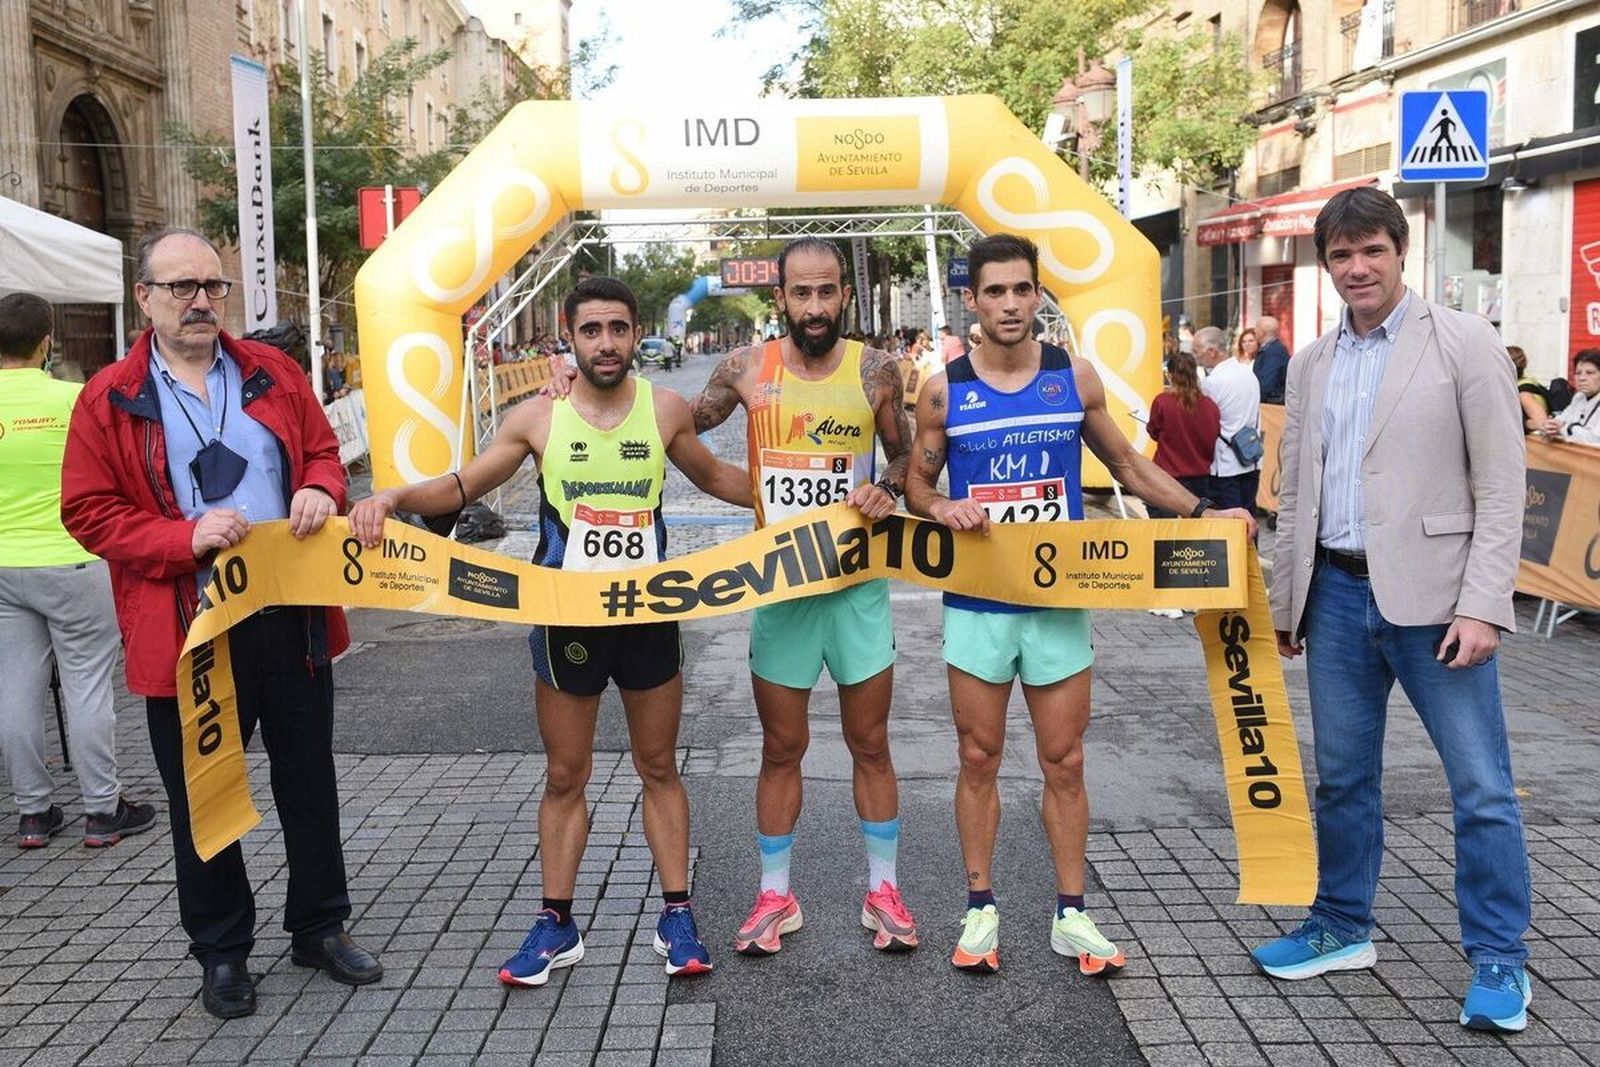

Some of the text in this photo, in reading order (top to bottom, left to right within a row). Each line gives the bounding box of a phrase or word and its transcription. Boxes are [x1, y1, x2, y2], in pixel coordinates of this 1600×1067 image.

[684, 118, 760, 147] IMD
[667, 168, 778, 181] Instituto Municipal
[829, 166, 845, 176] DE
[684, 183, 759, 195] de Deportes
[247, 116, 268, 323] CaixaBank
[960, 401, 987, 412] VIATOR
[815, 416, 862, 437] Álora
[1003, 429, 1076, 447] ATLETISMO
[765, 475, 849, 507] 13385
[383, 538, 427, 563] IMD
[584, 530, 645, 560] 668
[1082, 540, 1129, 560] IMD
[600, 514, 954, 617] #Sevilla10
[1161, 559, 1218, 568] AYUNTAMIENTO
[370, 571, 440, 585] Instituto Municipal
[1066, 571, 1144, 582] Instituto Municipal
[1180, 567, 1210, 576] SEVILLA
[378, 580, 425, 592] de Deportes
[1078, 581, 1132, 591] de Deportes
